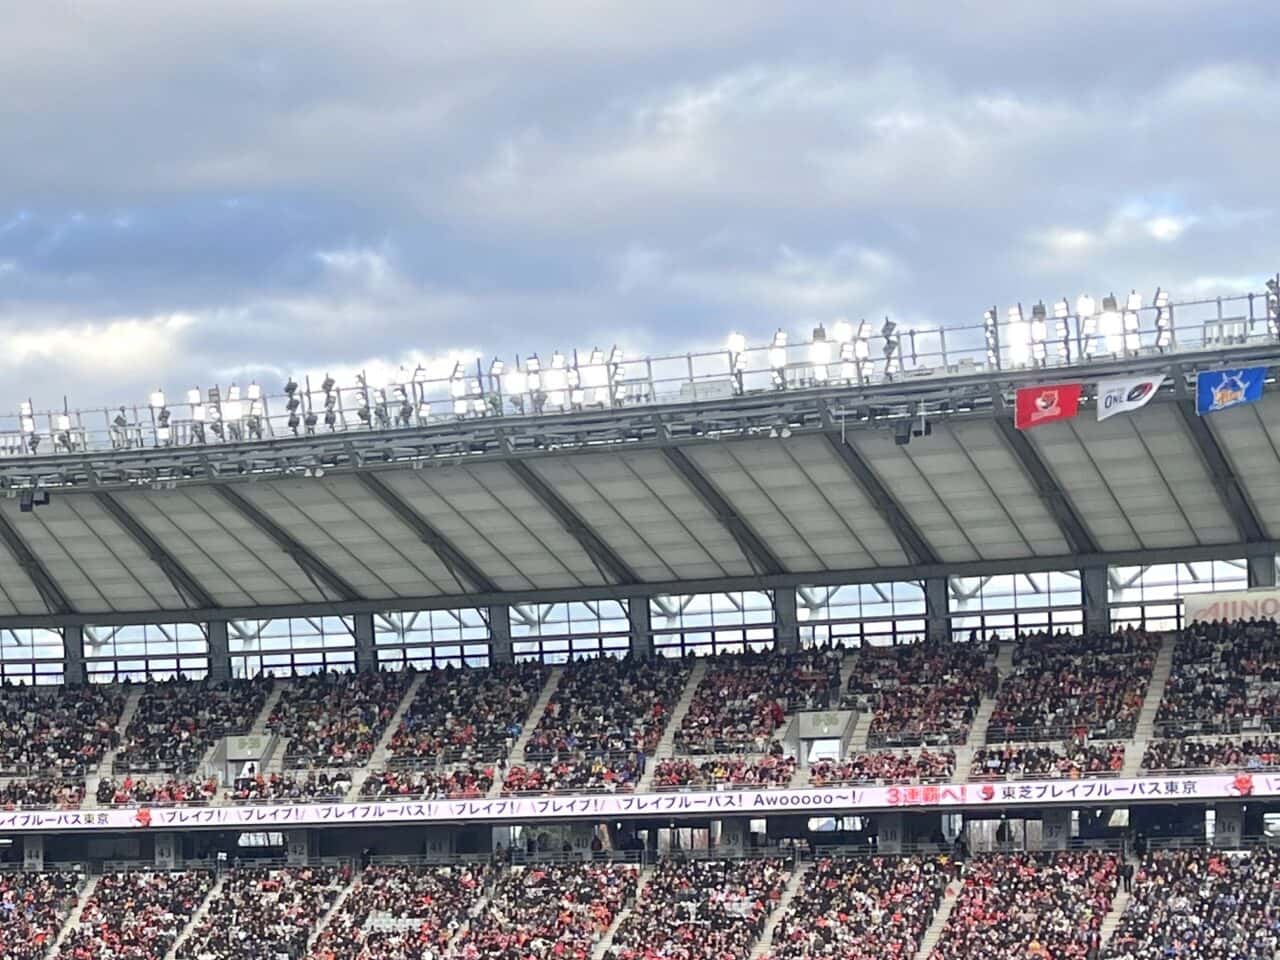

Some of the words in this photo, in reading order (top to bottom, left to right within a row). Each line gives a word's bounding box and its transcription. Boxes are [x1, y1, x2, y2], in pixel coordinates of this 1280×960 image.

[166, 808, 221, 823] ブレイブ!
[243, 807, 299, 822] ブレイブ!
[455, 801, 514, 815] ブレイブ!
[537, 799, 598, 813] ブレイブ!
